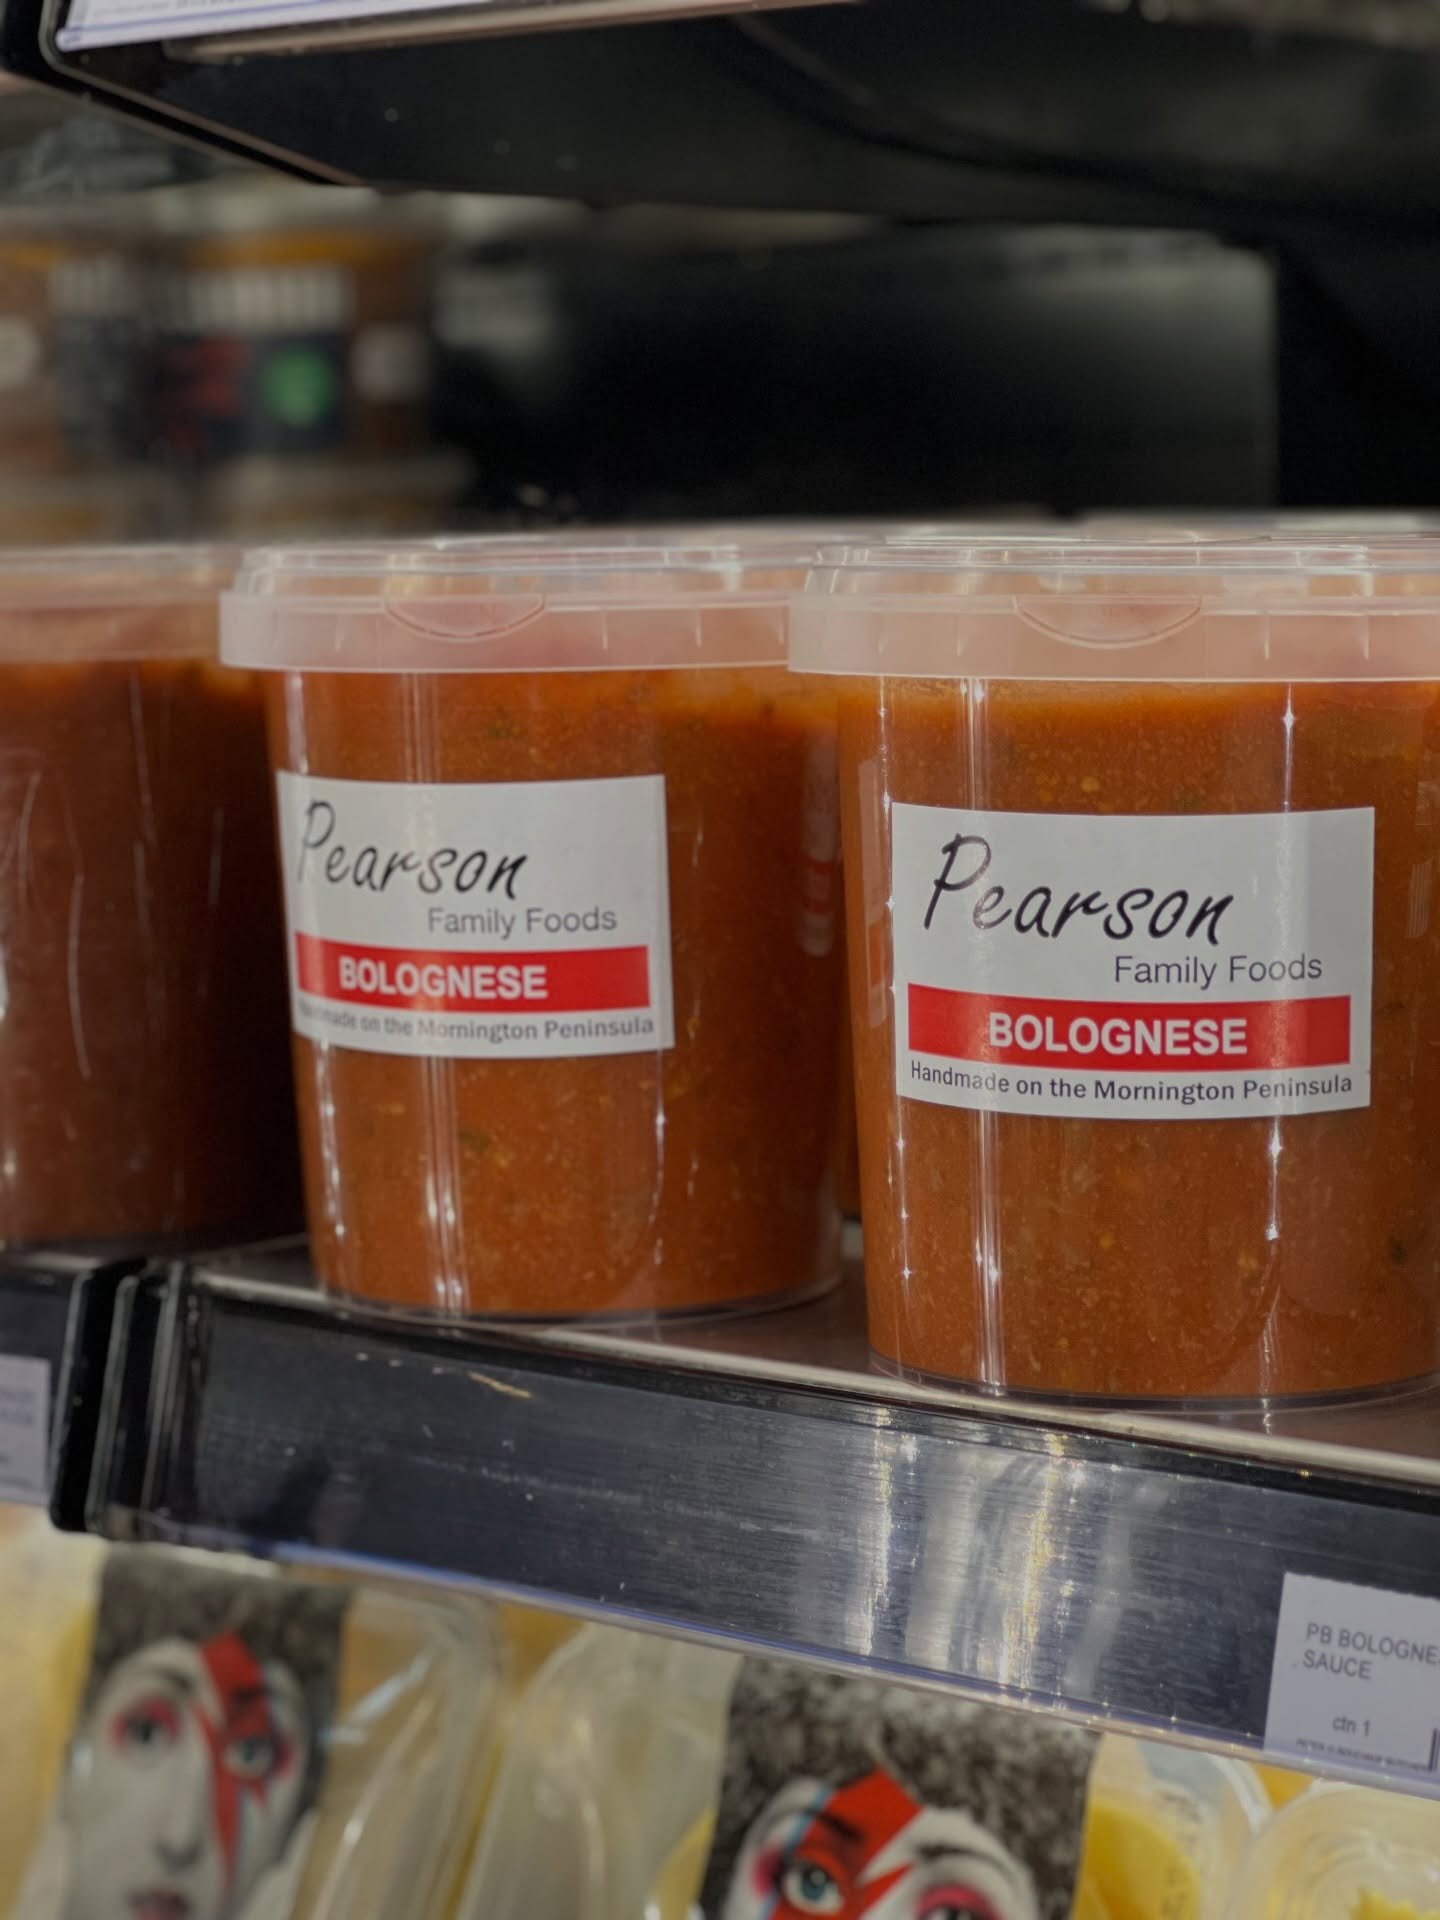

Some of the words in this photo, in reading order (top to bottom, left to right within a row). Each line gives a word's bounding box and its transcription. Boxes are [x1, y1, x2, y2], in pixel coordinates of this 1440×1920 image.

[298, 799, 529, 900] Pearson
[924, 832, 1235, 946] Pearson
[427, 907, 517, 940] Family
[526, 905, 618, 933] Foods
[338, 955, 549, 999] BOLOGNESE
[1114, 955, 1218, 991] Family
[1228, 953, 1323, 984] Foods
[360, 1015, 381, 1033] on
[384, 1014, 413, 1036] the
[416, 1017, 538, 1045] Mornington
[543, 1015, 655, 1039] Peninsula
[988, 1011, 1249, 1056] BOLOGNESE
[911, 1059, 1010, 1093] Handmade
[1015, 1078, 1043, 1097] on
[1049, 1077, 1087, 1099] the
[1094, 1079, 1235, 1106] Mornington
[1243, 1074, 1353, 1100] Peninsula
[1302, 1649, 1373, 1680] SAUCE
[1305, 1622, 1333, 1645] PB
[1337, 1628, 1440, 1666] BOLOGNE
[1362, 1719, 1371, 1737] 1
